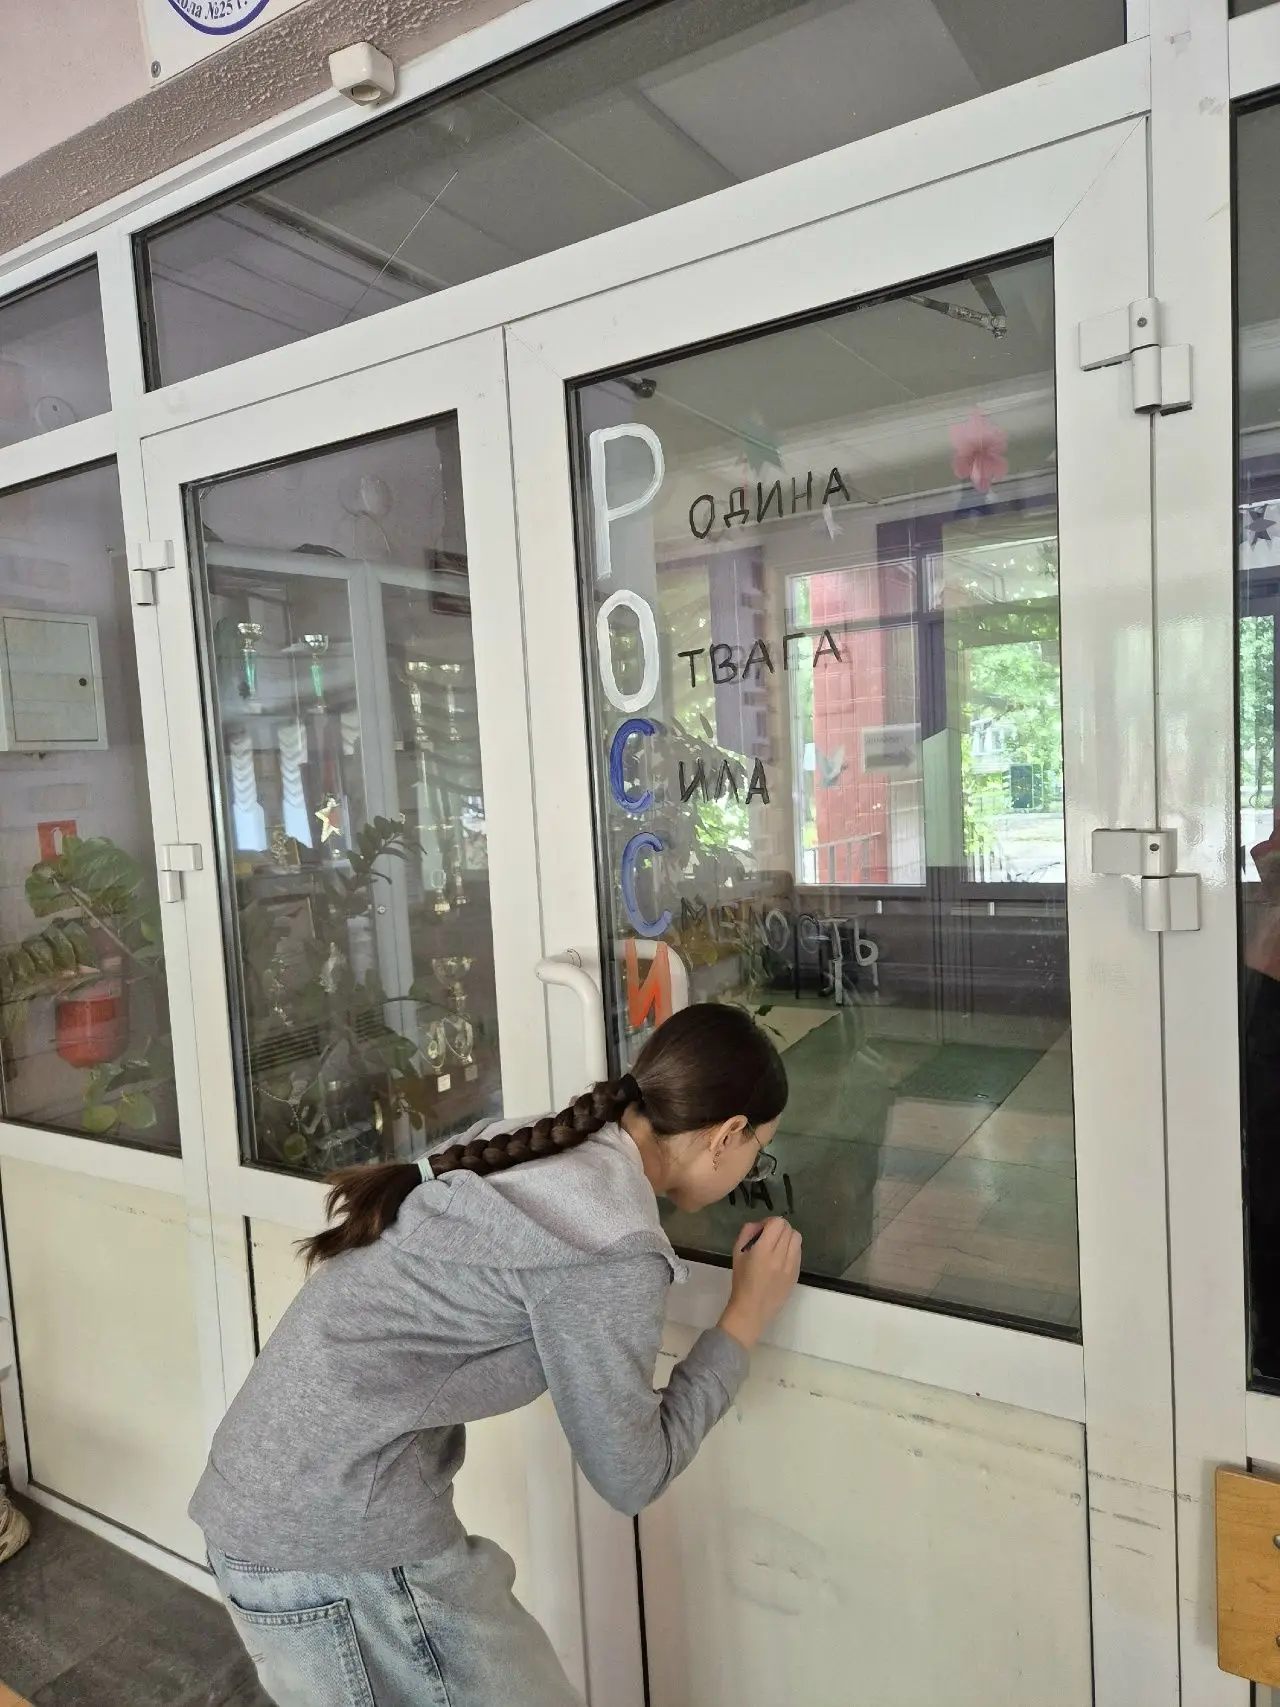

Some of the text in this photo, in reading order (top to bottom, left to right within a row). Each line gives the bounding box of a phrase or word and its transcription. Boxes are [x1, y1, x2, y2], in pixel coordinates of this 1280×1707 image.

[689, 467, 850, 539] ОДИНА
[678, 629, 842, 687] ТВАГА
[678, 757, 770, 805] ИЛА
